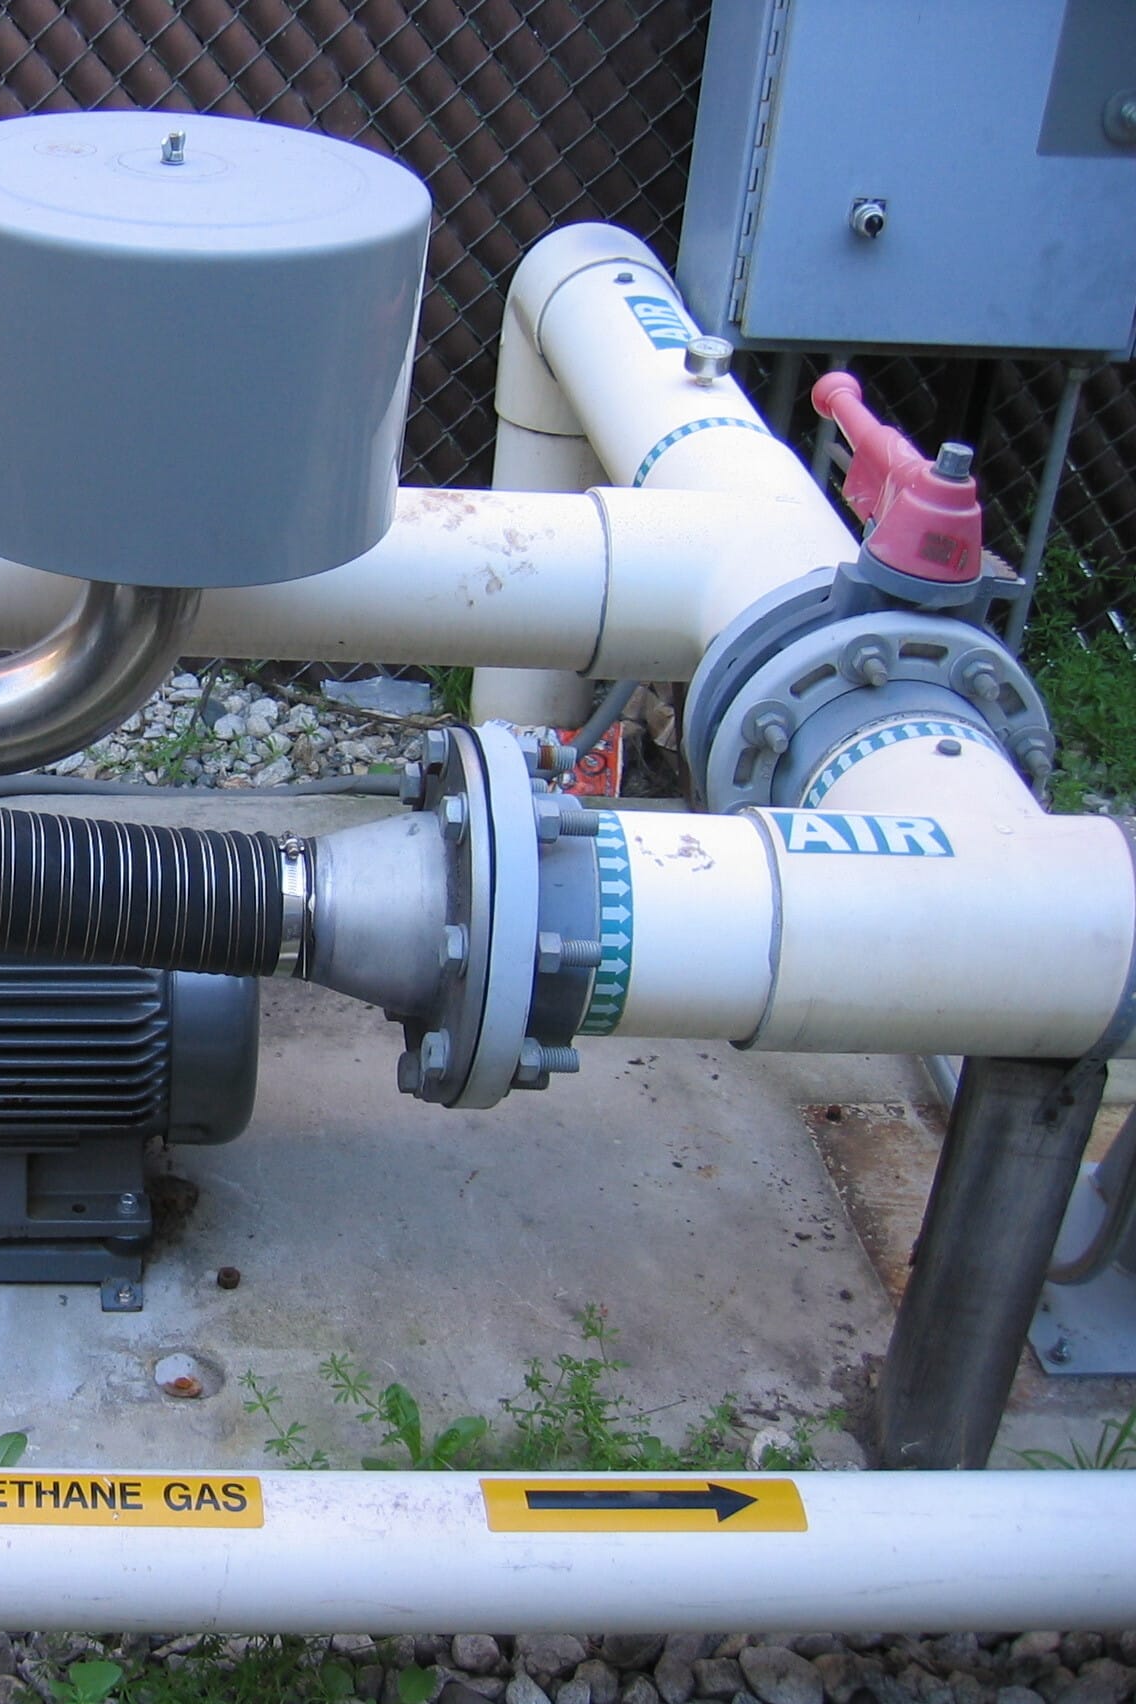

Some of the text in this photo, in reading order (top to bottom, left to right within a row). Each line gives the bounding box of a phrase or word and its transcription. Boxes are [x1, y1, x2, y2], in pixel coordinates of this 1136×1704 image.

[632, 303, 690, 343] AIR
[788, 814, 947, 856] AIR
[163, 1482, 247, 1512] GAS
